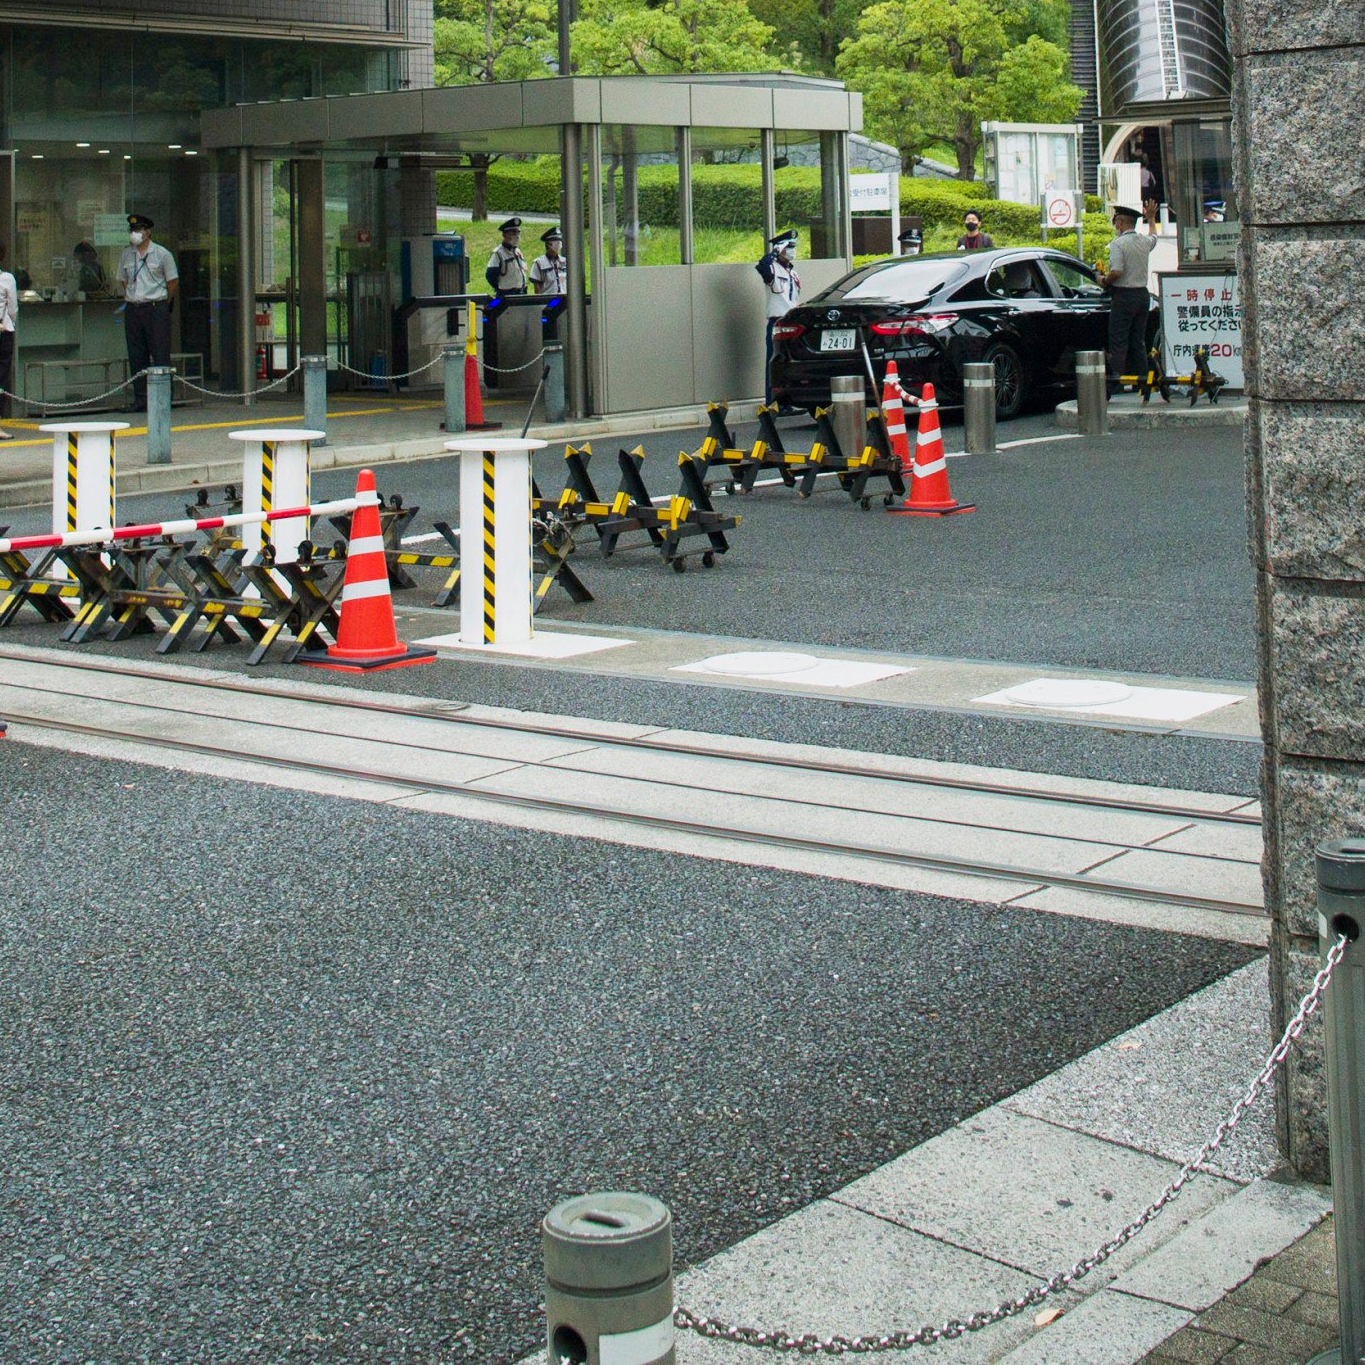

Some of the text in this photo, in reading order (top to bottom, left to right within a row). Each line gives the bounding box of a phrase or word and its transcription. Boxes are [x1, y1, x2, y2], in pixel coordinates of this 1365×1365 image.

[1171, 288, 1232, 302] 一時停止
[828, 337, 852, 349] 24-01
